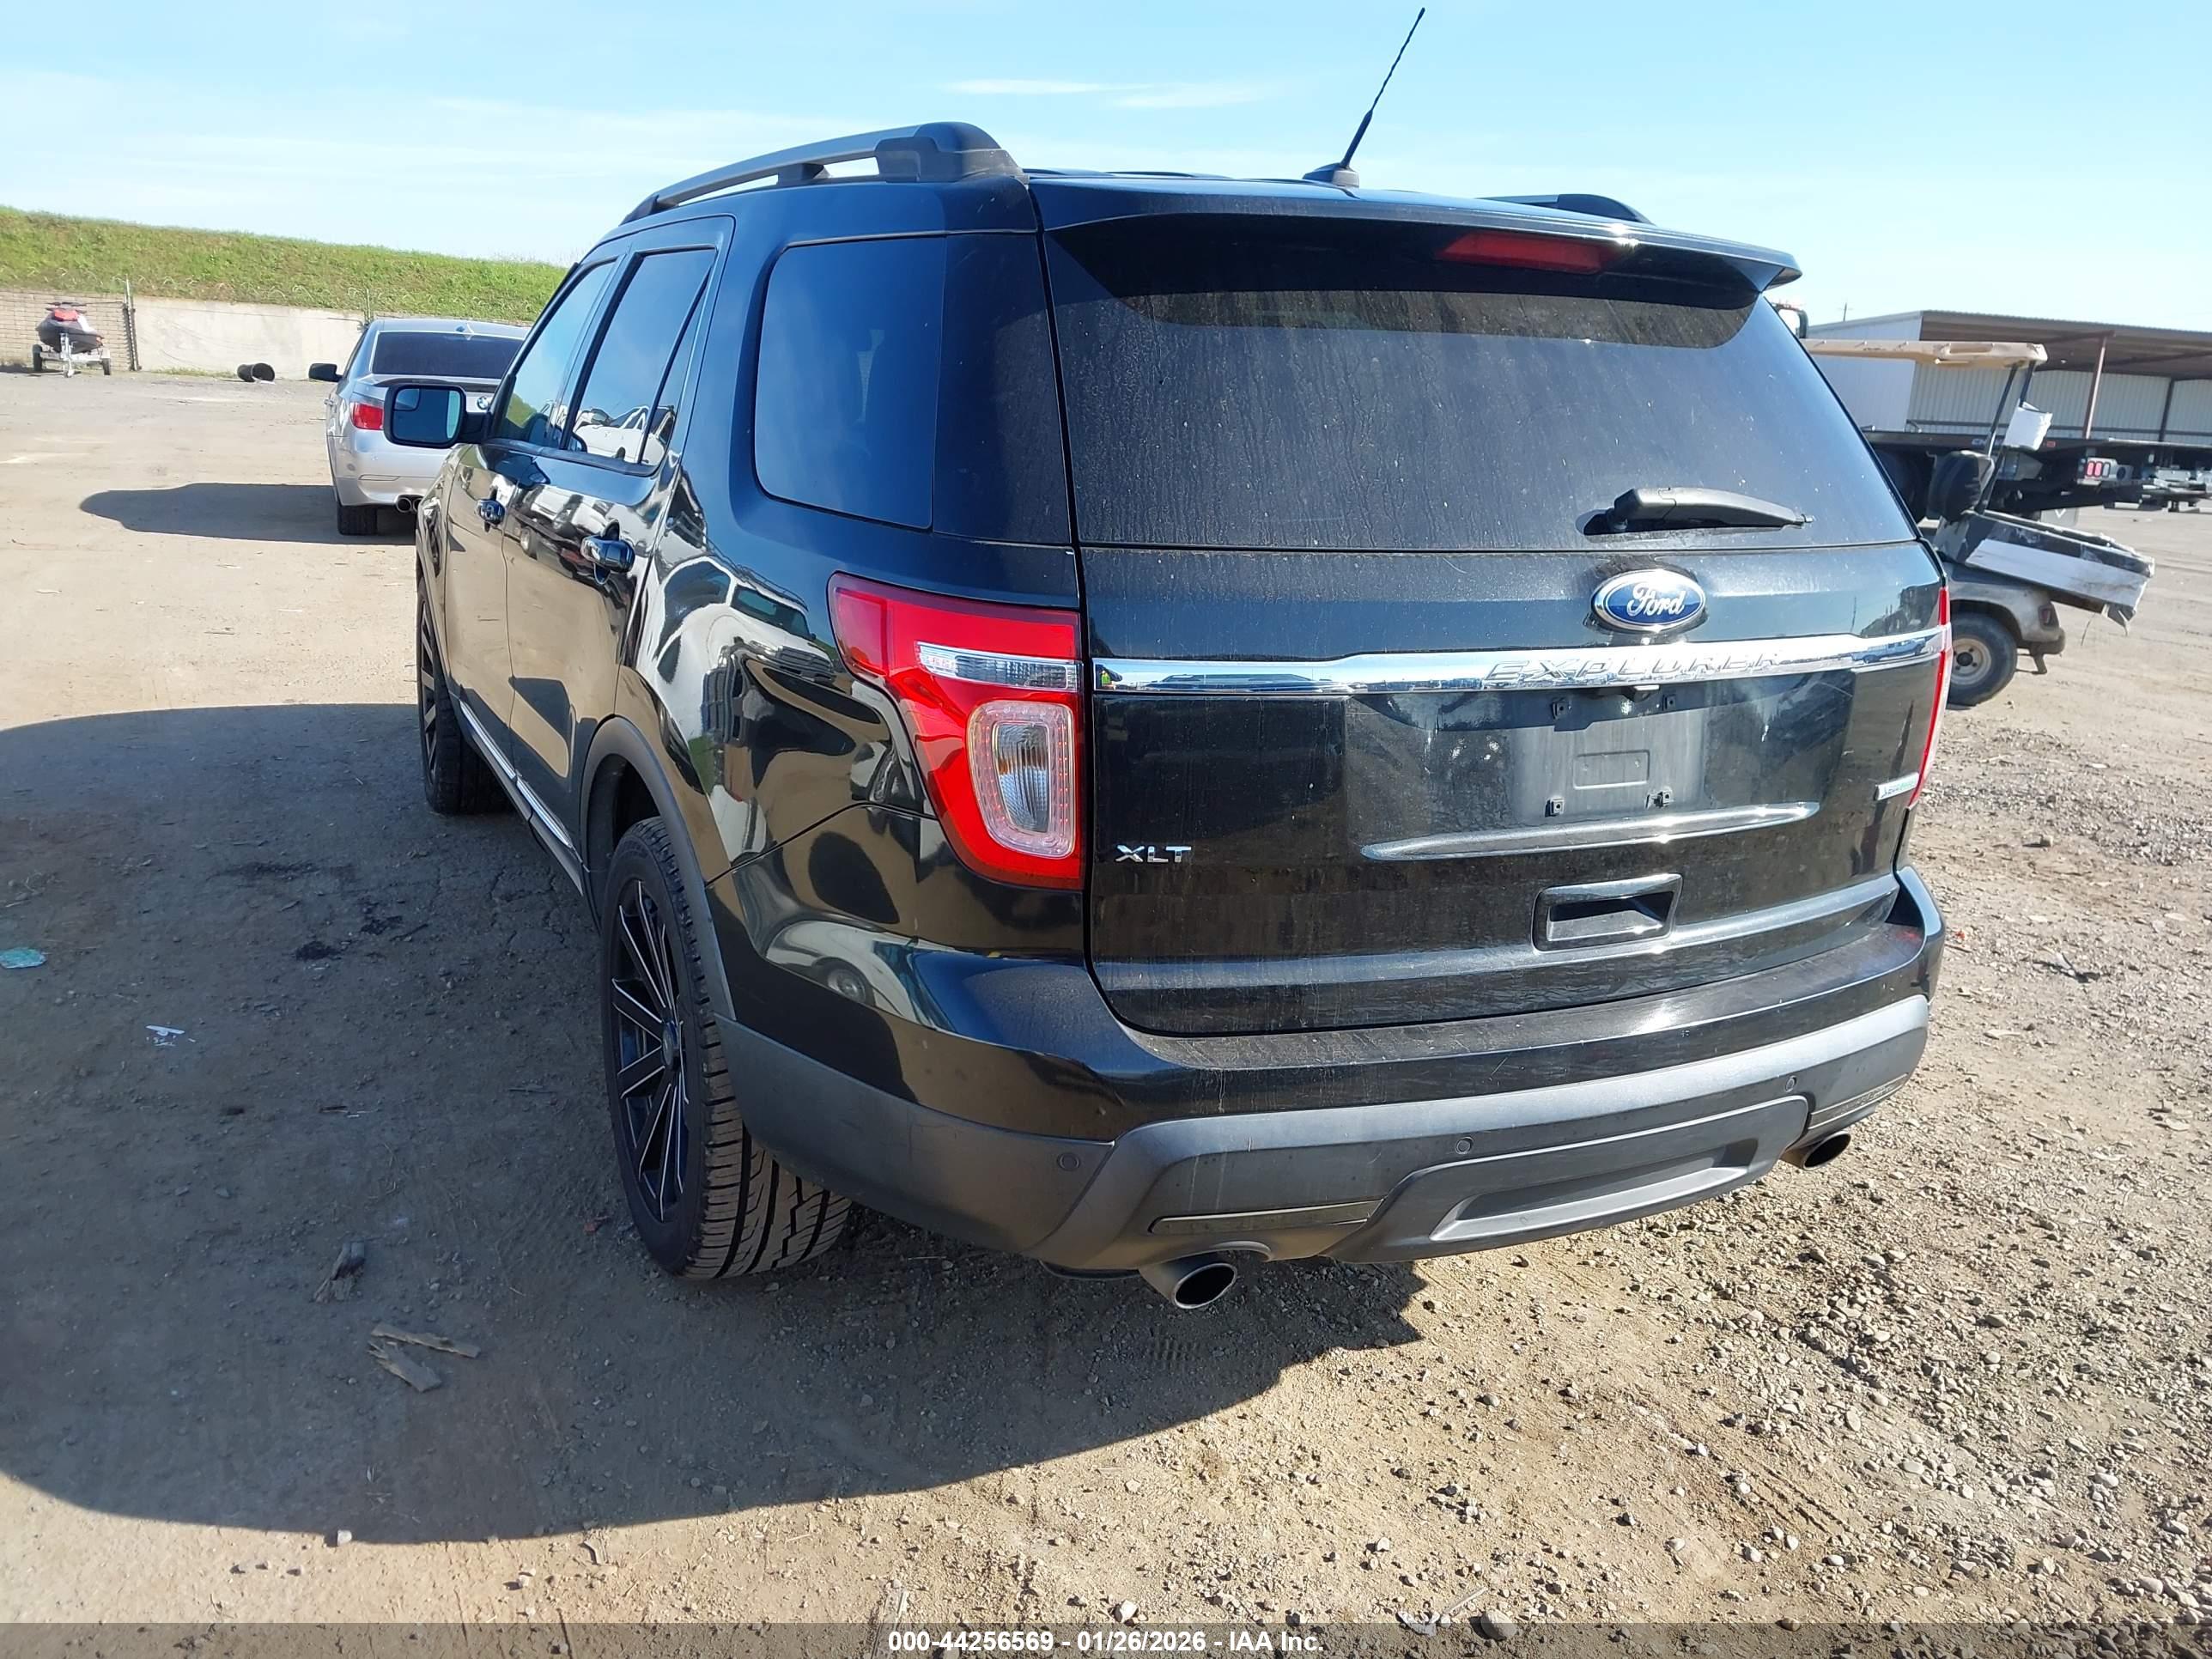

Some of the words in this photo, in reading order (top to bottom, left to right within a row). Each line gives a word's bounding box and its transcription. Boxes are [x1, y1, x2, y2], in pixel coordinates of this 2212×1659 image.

[1626, 583, 1687, 617] Ford
[1483, 649, 1785, 683] EXPLORER
[1115, 844, 1192, 863] XLT
